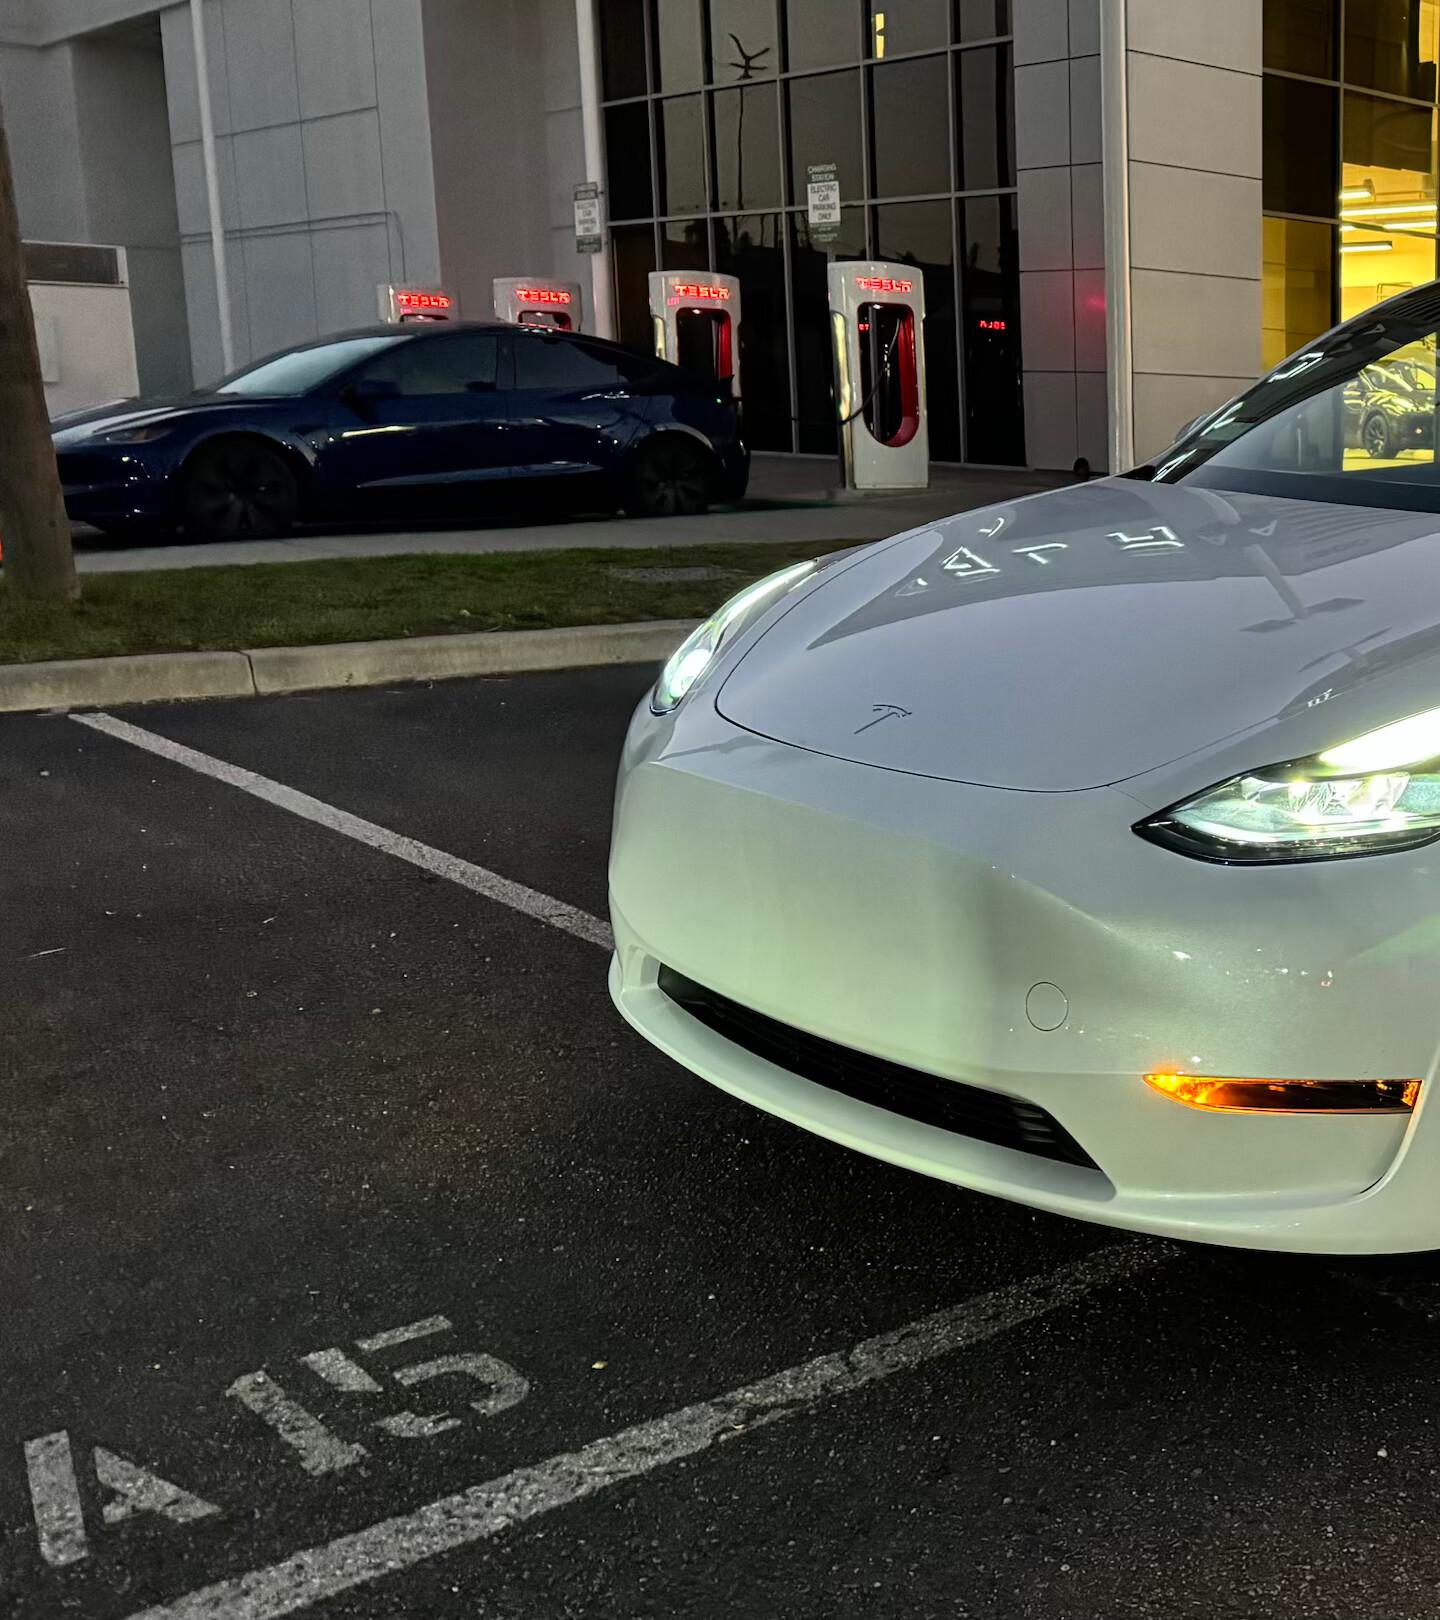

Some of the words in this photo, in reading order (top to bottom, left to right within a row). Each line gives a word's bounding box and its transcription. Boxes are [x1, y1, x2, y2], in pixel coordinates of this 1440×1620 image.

[818, 194, 830, 202] CAR
[856, 277, 912, 293] TESLA
[516, 290, 571, 304] TESLA
[674, 285, 730, 300] TESLA
[397, 294, 450, 308] TESLA
